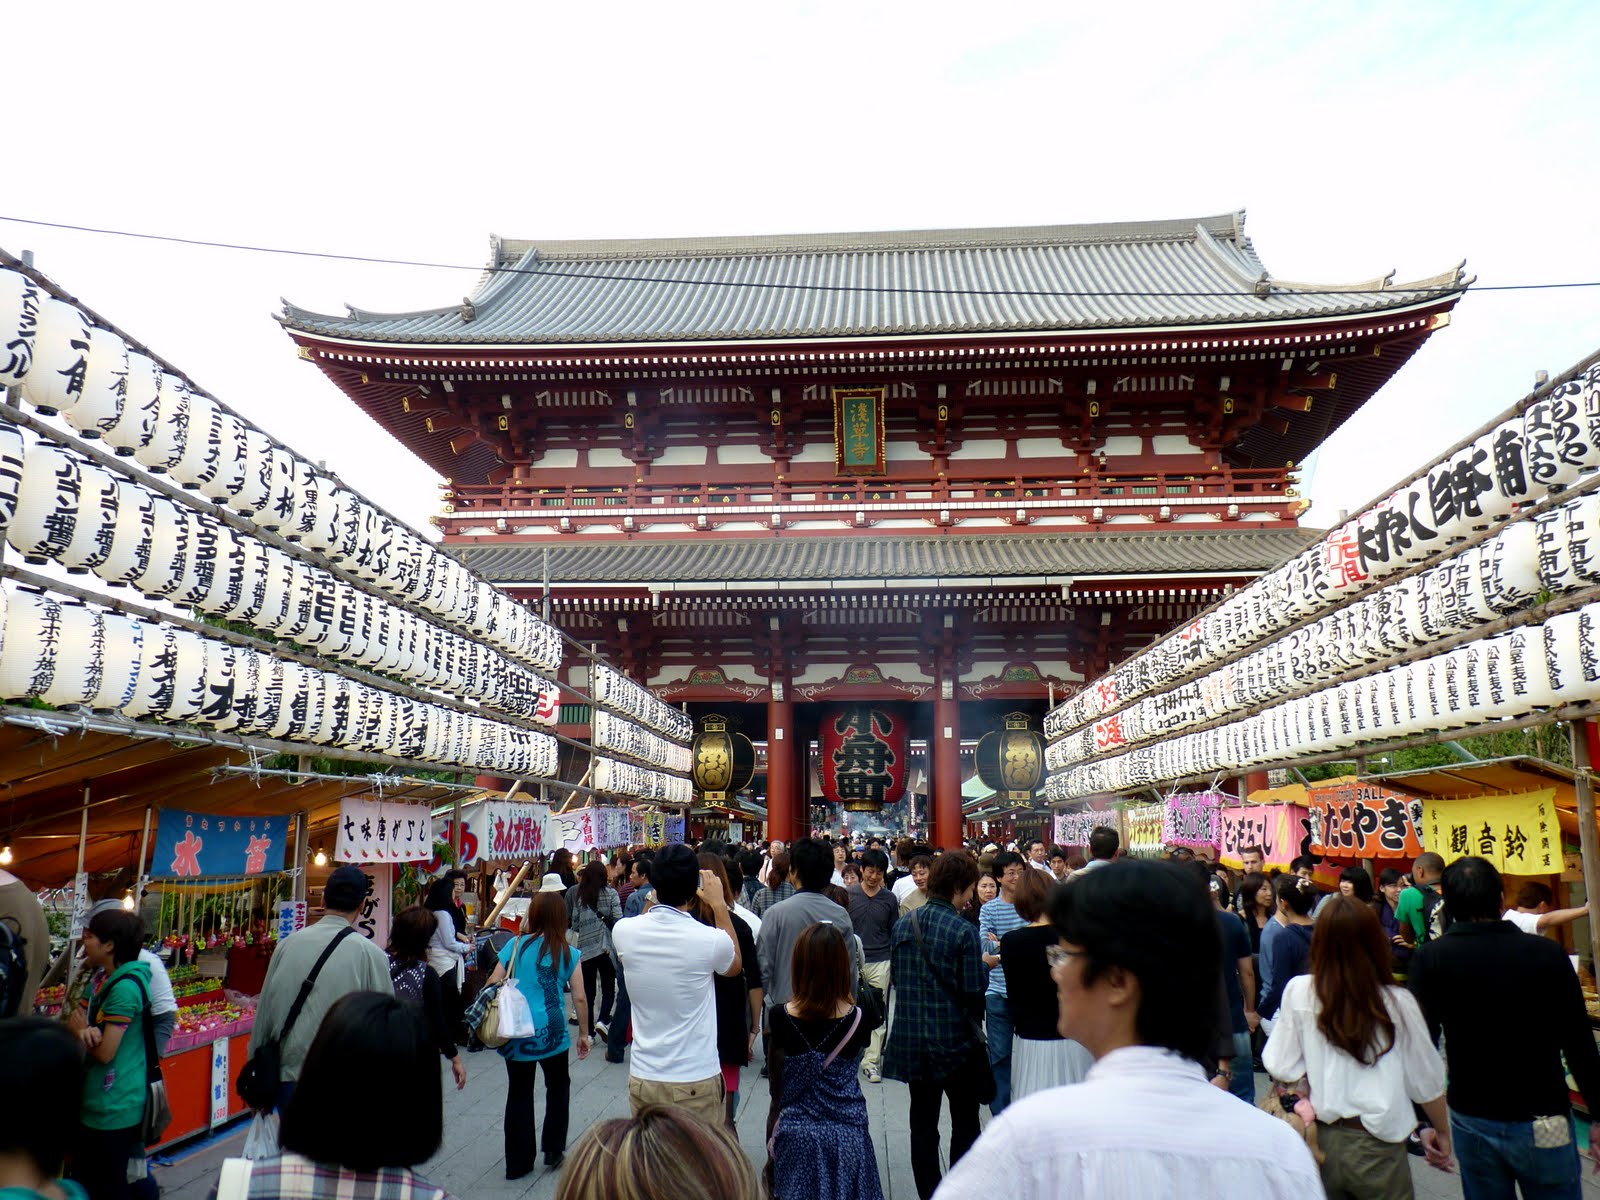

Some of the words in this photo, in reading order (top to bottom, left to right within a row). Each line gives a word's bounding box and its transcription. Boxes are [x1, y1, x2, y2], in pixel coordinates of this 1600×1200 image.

[296, 467, 319, 533] 大黒家
[1357, 787, 1385, 801] BALL
[344, 815, 427, 842] 七味唐がらし
[494, 815, 542, 852] あんず屋さん
[580, 813, 594, 845] 味自慢
[1323, 799, 1409, 850] たこやき
[1450, 821, 1528, 862] 観音鈴
[171, 831, 272, 876] 水笛
